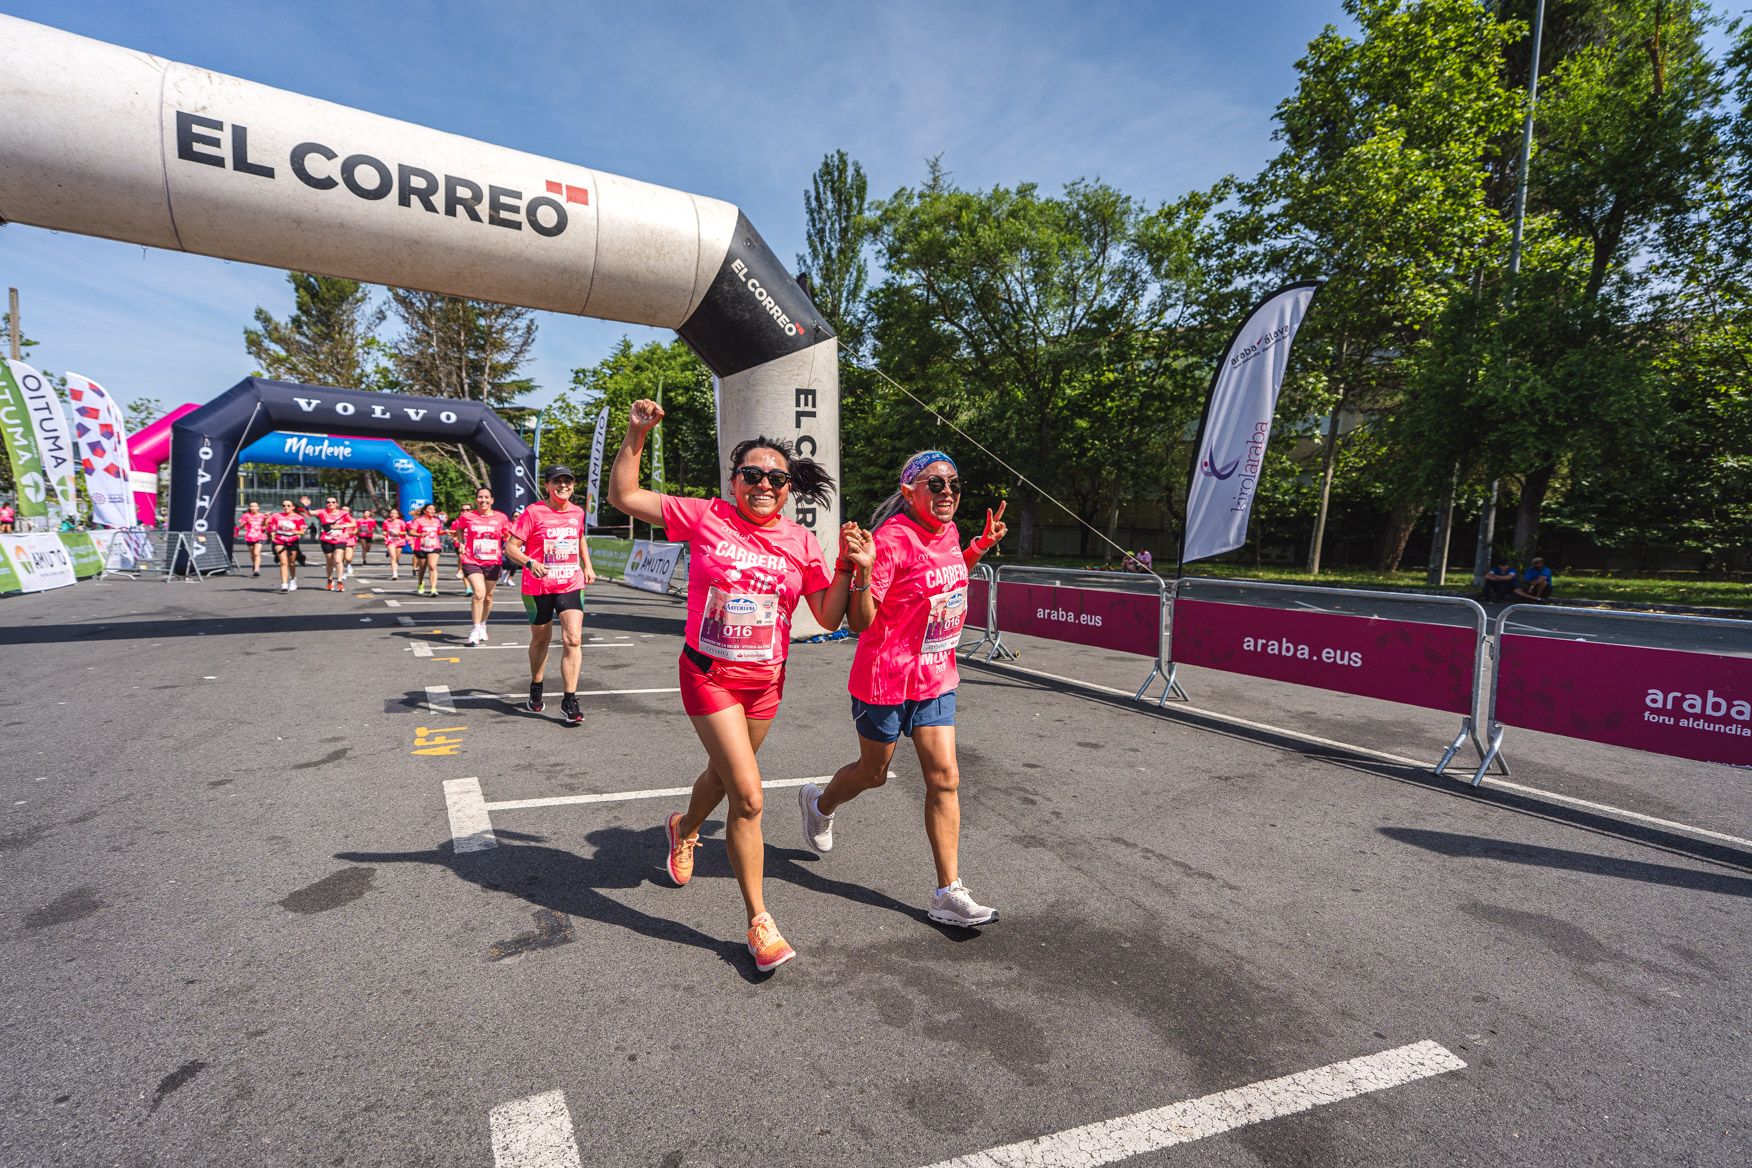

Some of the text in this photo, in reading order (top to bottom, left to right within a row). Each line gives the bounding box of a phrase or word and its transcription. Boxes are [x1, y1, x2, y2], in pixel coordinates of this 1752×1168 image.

[176, 110, 569, 238] EL CORREO
[731, 258, 797, 336] EL CORREO
[1231, 344, 1257, 365] araba
[293, 397, 458, 424] VOLVO
[795, 388, 817, 428] EL
[591, 415, 605, 489] AMUTIO
[1230, 421, 1268, 512] kirolaraba
[192, 446, 214, 558] VOLVO
[514, 465, 526, 514] LVO
[640, 556, 670, 575] AMUTIO
[722, 625, 753, 637] 016
[944, 616, 960, 629] 016
[1037, 607, 1103, 628] araba.eus
[1243, 637, 1363, 668] araba.eus
[1645, 688, 1752, 721] araba
[1643, 711, 1752, 737] foru aldundia
